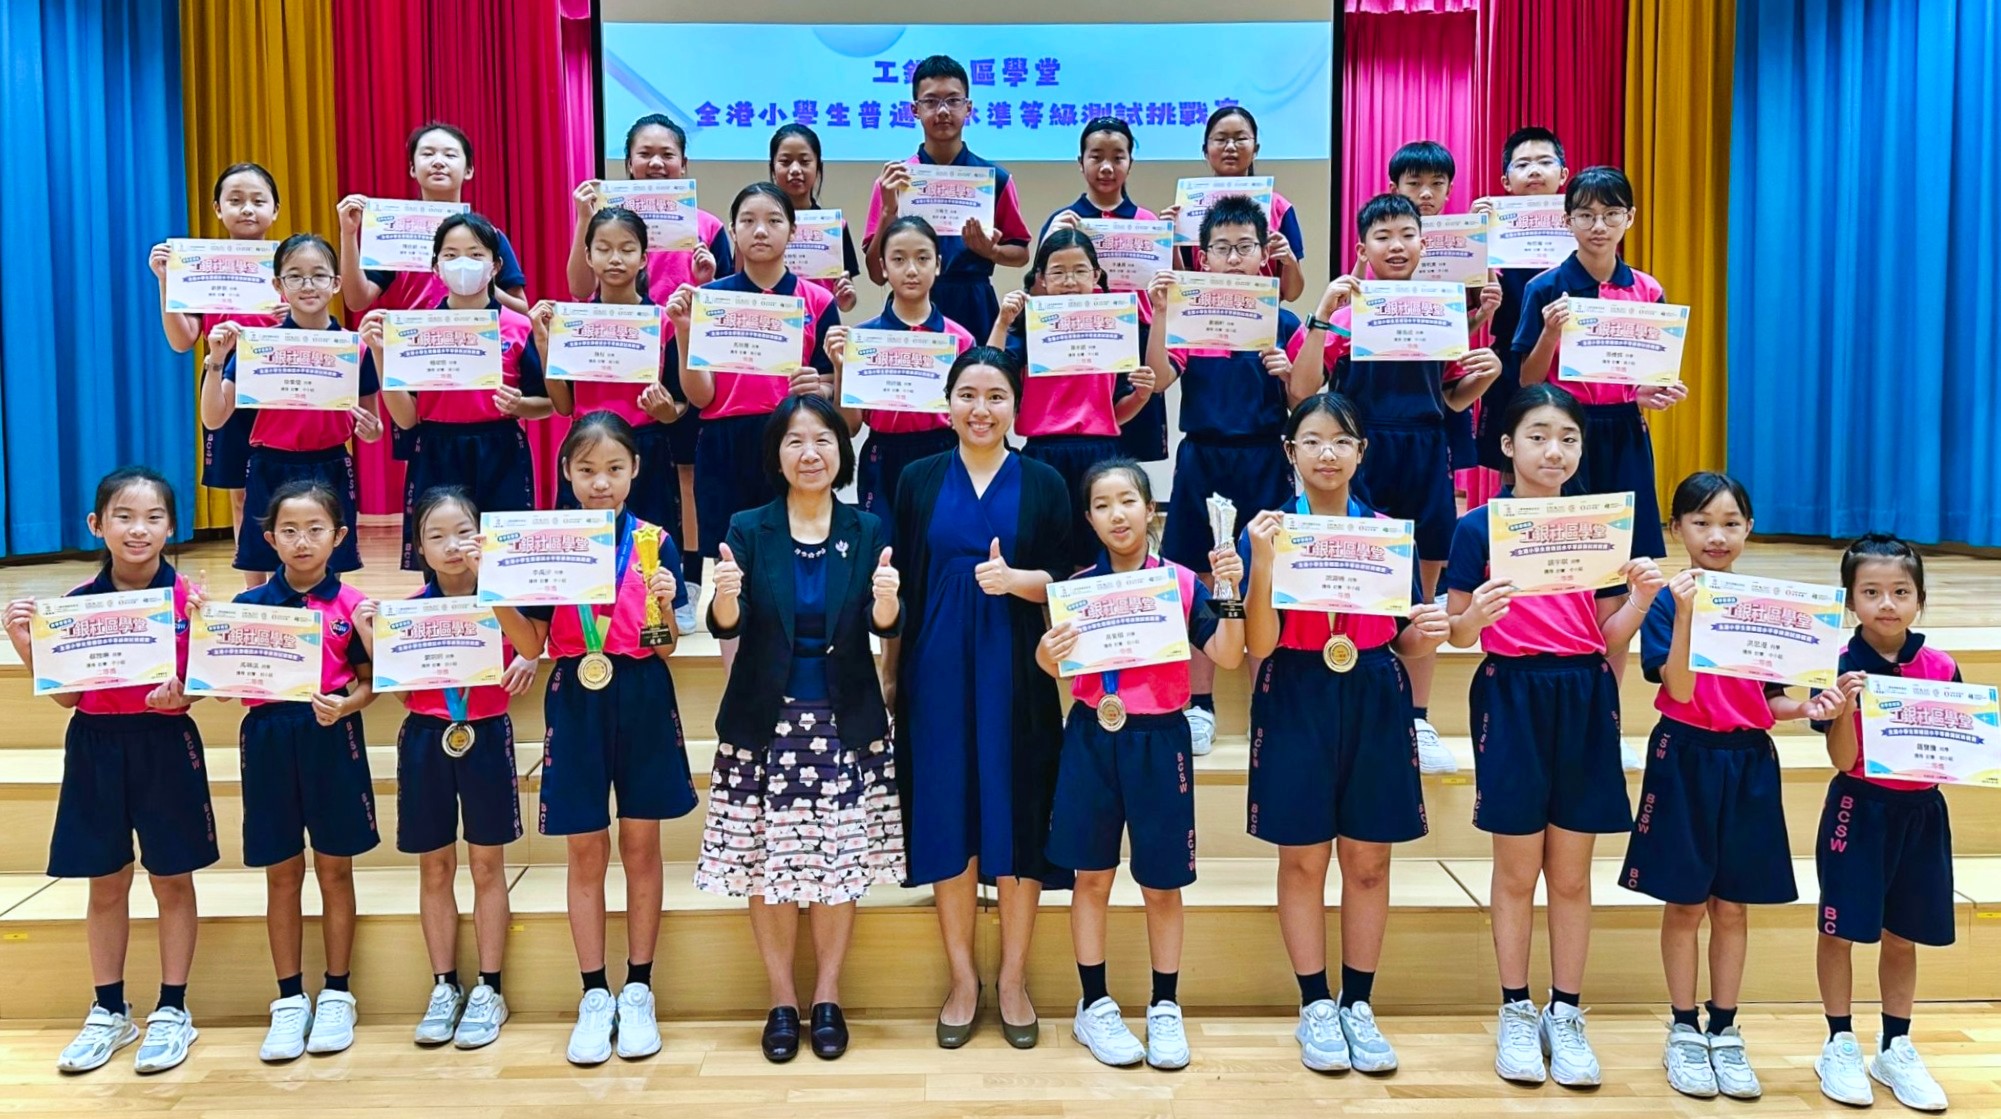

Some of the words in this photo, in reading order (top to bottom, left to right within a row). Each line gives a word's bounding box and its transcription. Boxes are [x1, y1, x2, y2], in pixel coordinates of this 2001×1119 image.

[873, 58, 1060, 87] 工區學堂
[183, 731, 200, 770] BCSW
[1177, 752, 1188, 793] BCSW
[1638, 793, 1656, 834] BCSW
[1830, 795, 1854, 853] BCSW
[1824, 906, 1837, 936] BC
